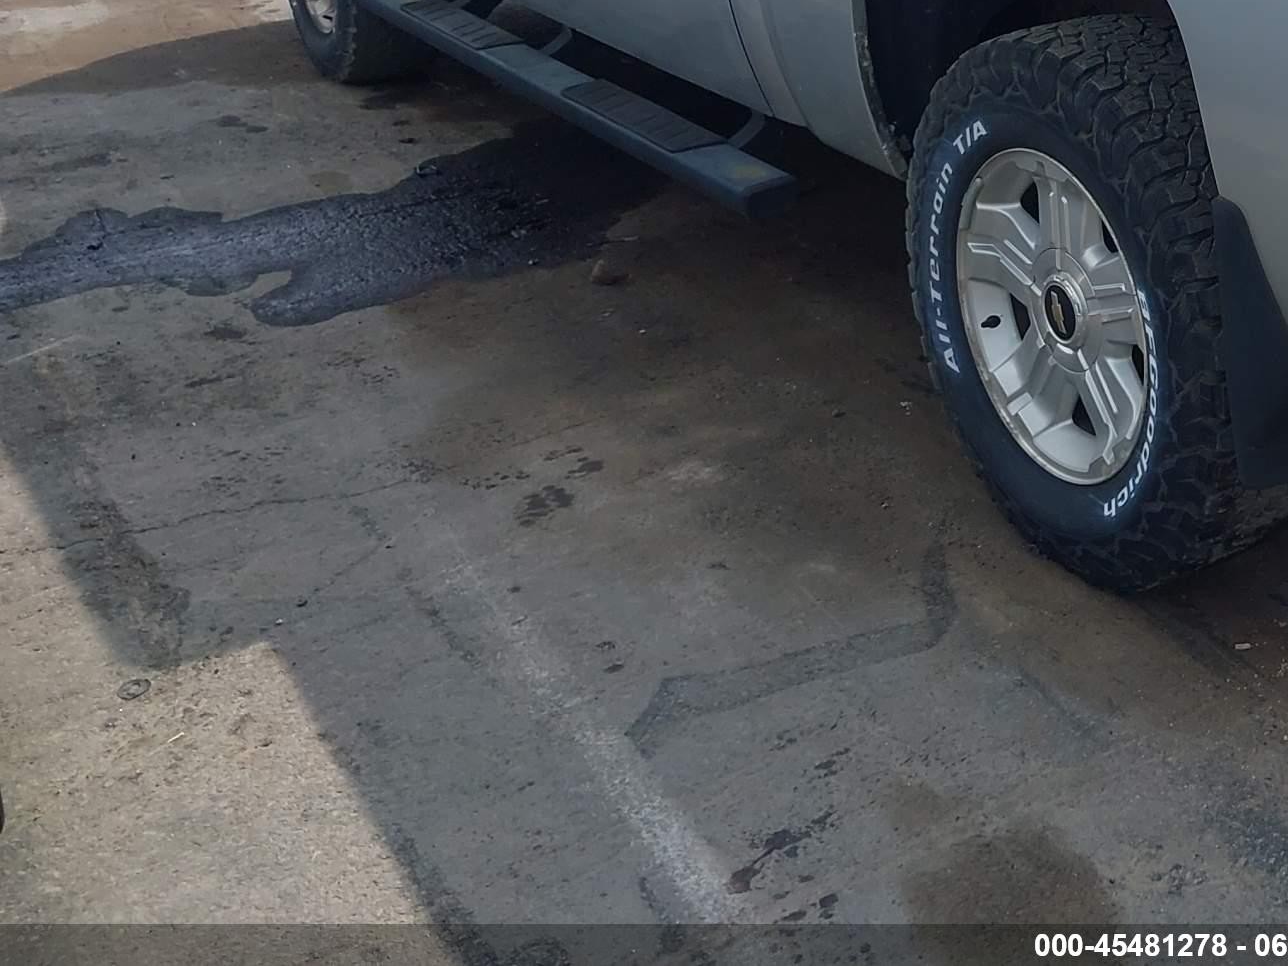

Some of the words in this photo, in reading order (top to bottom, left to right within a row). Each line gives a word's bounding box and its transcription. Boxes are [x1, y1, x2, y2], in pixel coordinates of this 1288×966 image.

[928, 161, 961, 374] All-Terrain
[952, 119, 988, 156] T/A
[1103, 289, 1159, 518] BFGoodrich
